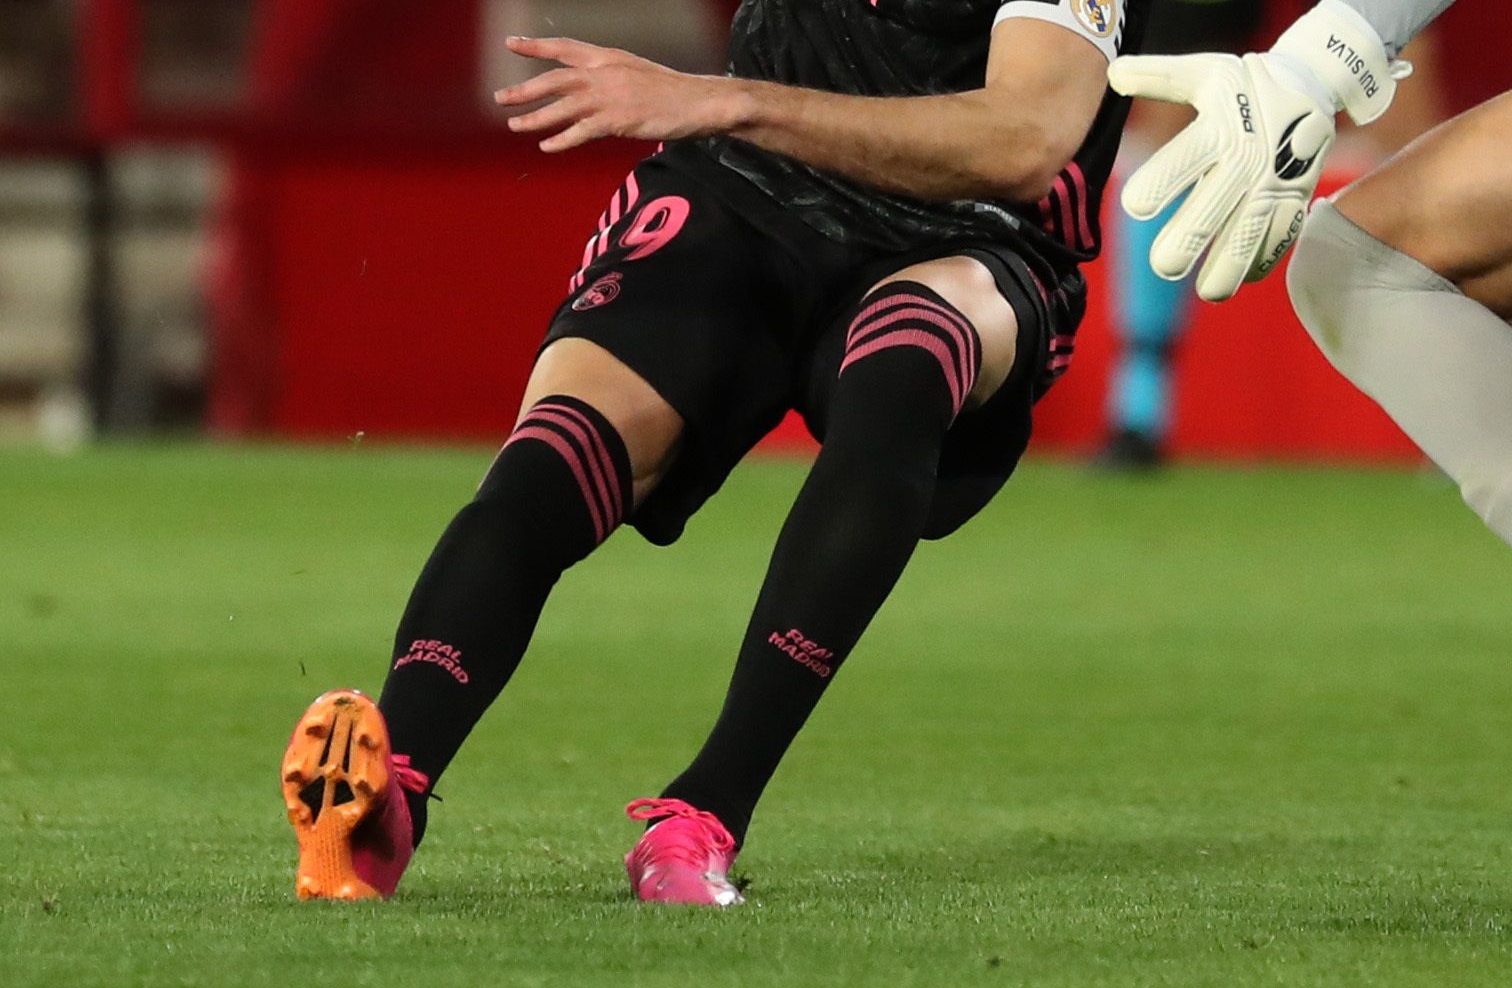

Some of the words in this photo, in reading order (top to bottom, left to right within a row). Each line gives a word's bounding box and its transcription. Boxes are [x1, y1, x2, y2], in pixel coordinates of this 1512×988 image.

[1326, 34, 1365, 76] SILVA
[1358, 69, 1380, 99] RUI
[1236, 93, 1256, 134] PRO
[409, 639, 462, 664] REAL
